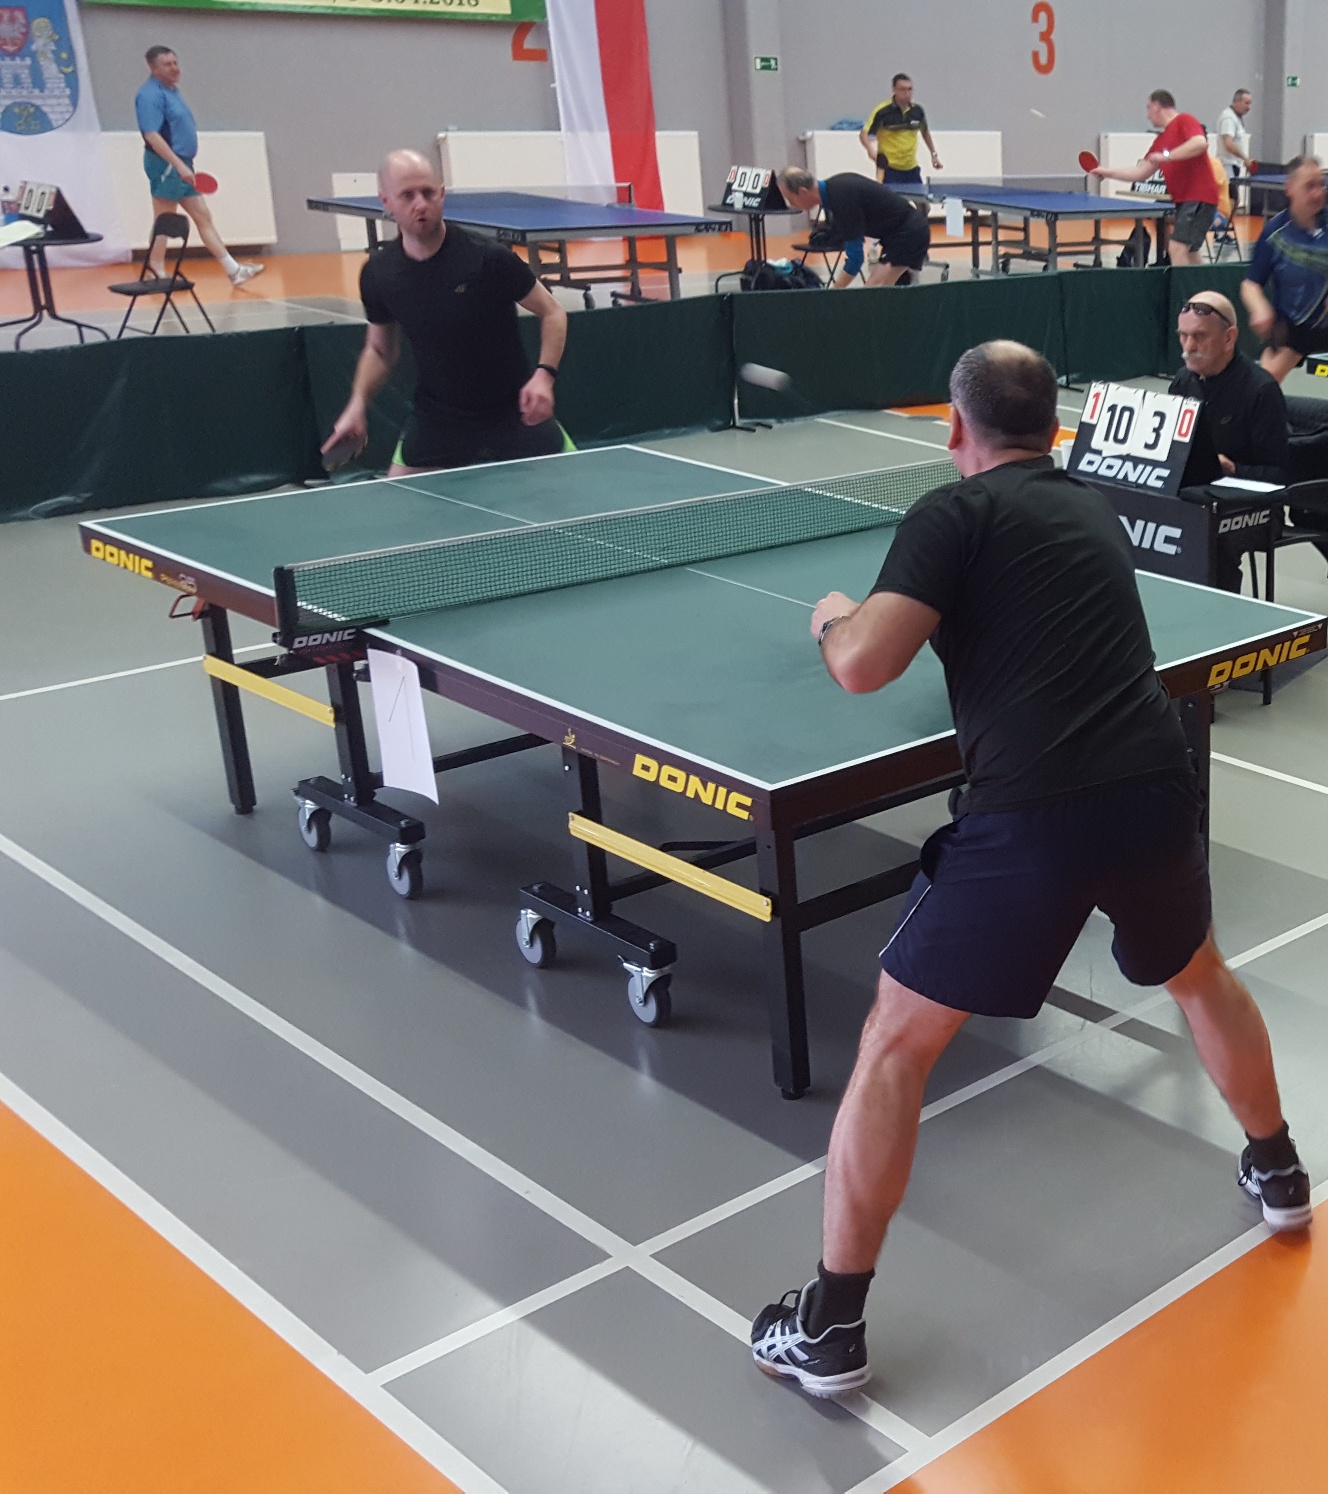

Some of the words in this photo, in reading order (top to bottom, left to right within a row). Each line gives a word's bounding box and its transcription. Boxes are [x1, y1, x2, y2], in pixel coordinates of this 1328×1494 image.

[1031, 1, 1056, 75] 3
[726, 194, 761, 207] DNIC
[738, 172, 747, 188] 0
[752, 173, 760, 189] 0
[1089, 391, 1101, 420] 1
[1103, 403, 1135, 445] 10
[1143, 411, 1167, 451] 3
[1177, 408, 1195, 438] 0
[1077, 452, 1171, 489] DONIC
[1118, 514, 1182, 555] NIC
[1218, 509, 1270, 534] DONIC
[90, 538, 154, 579] DONIC
[292, 629, 356, 649] DONIC
[1207, 634, 1311, 687] DONIC
[632, 753, 753, 821] DONIC
